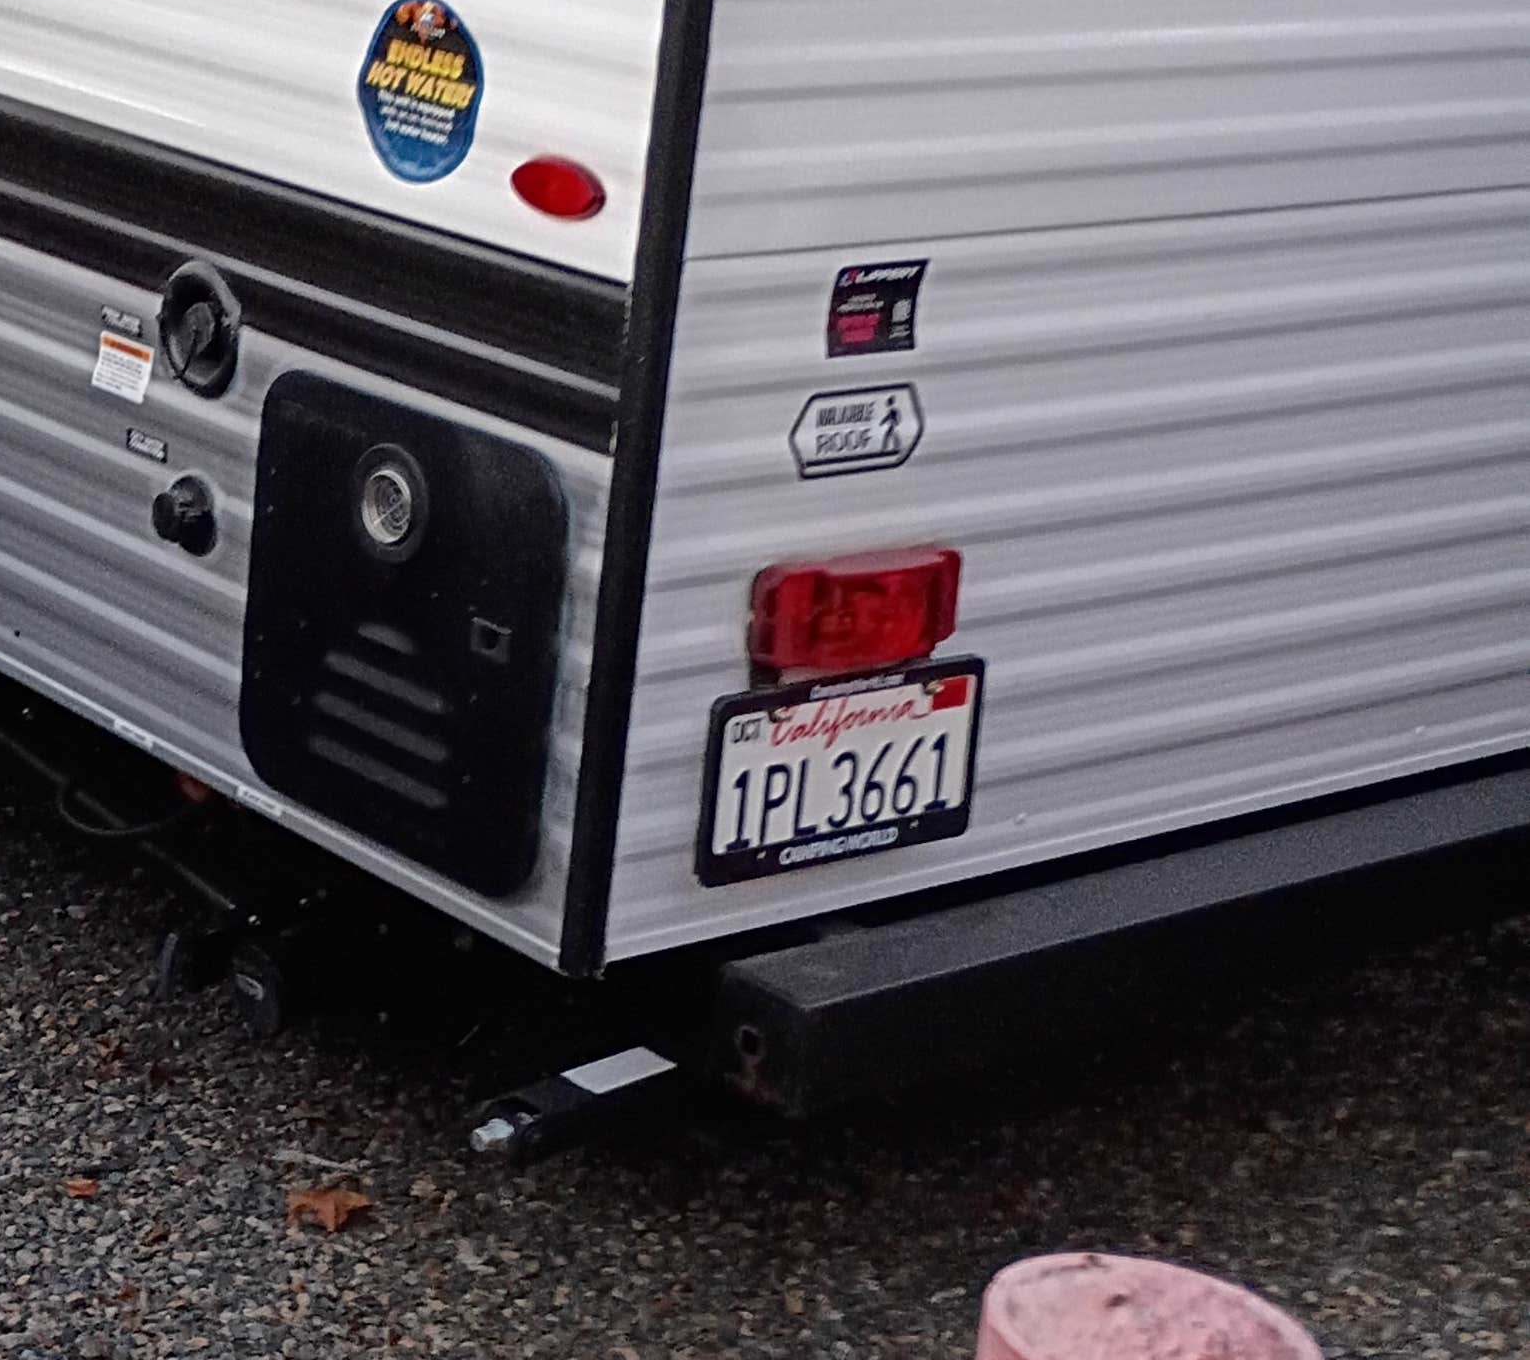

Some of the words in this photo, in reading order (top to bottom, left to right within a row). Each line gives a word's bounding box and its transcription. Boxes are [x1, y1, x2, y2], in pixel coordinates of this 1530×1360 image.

[365, 60, 409, 91] HOT
[772, 697, 930, 750] California
[725, 732, 949, 852] 1PL3661
